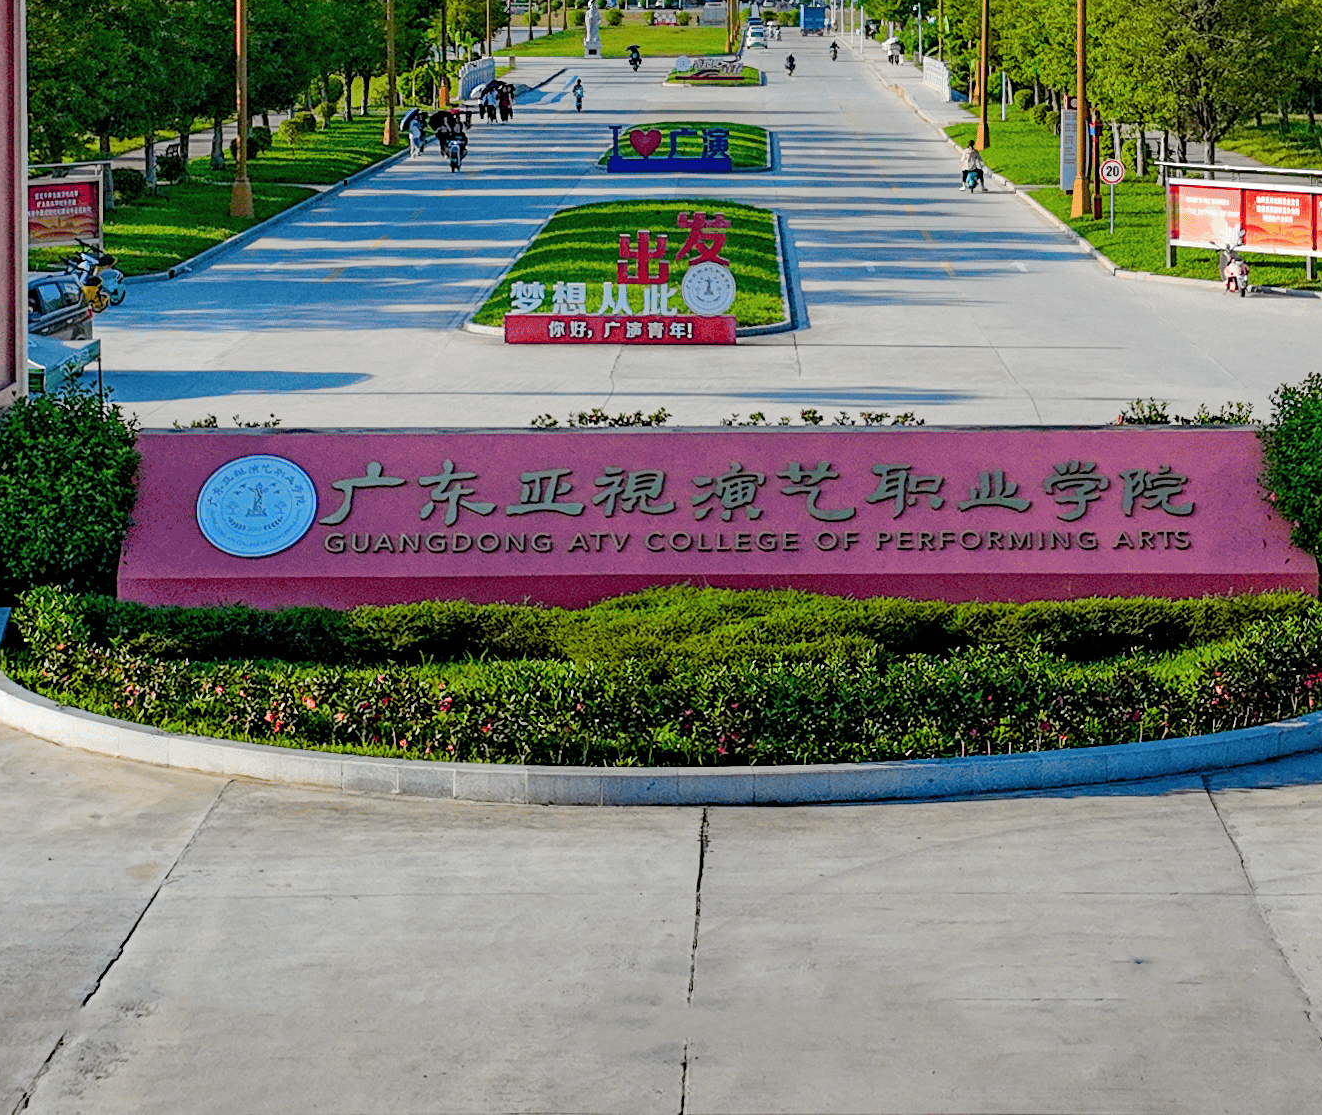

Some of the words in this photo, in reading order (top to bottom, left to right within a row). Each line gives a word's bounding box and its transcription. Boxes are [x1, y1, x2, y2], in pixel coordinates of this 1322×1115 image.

[670, 128, 730, 159] 广演
[1106, 166, 1119, 176] 20
[510, 281, 678, 316] 梦想从此
[324, 531, 553, 555] GUANGDONG
[568, 531, 631, 553] ATV
[646, 530, 800, 553] COLLEGE
[815, 530, 860, 552] OF
[875, 530, 1099, 551] PERFORMING
[1112, 529, 1193, 551] ARTS
